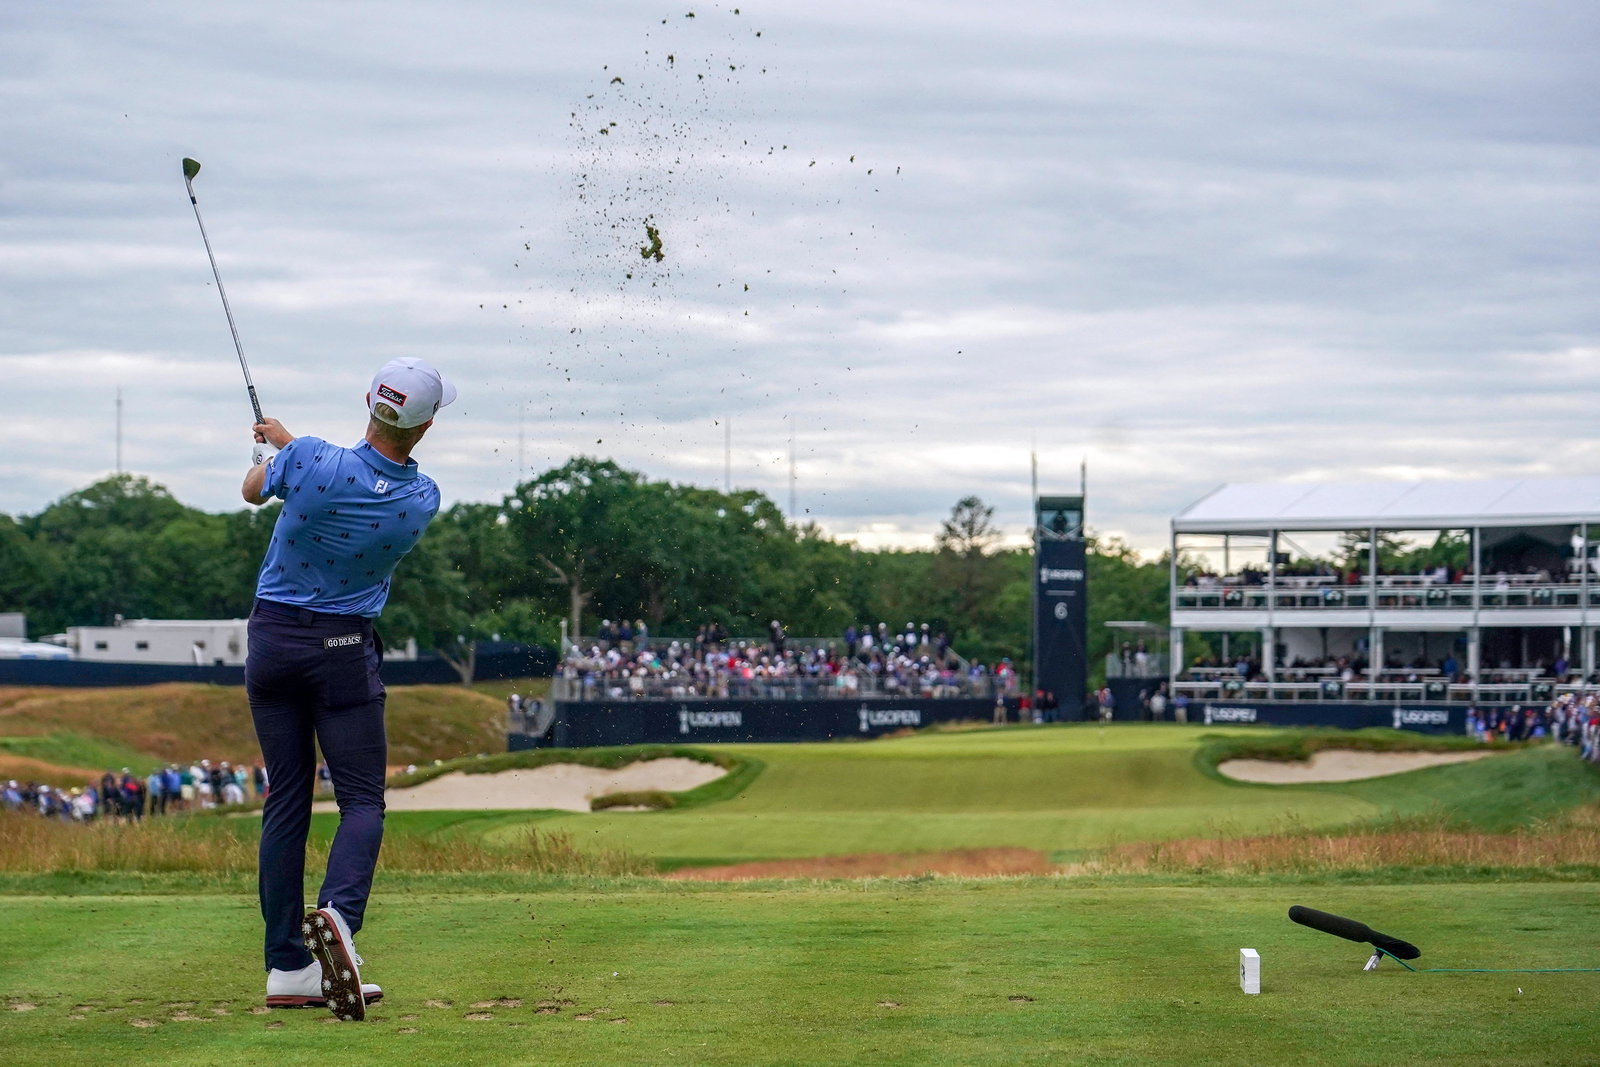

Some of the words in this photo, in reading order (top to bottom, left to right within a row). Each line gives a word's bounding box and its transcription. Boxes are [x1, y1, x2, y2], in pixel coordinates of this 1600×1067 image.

[379, 386, 403, 404] Titleist
[374, 479, 389, 494] FJ
[1054, 601, 1068, 620] 6
[327, 639, 339, 648] GO
